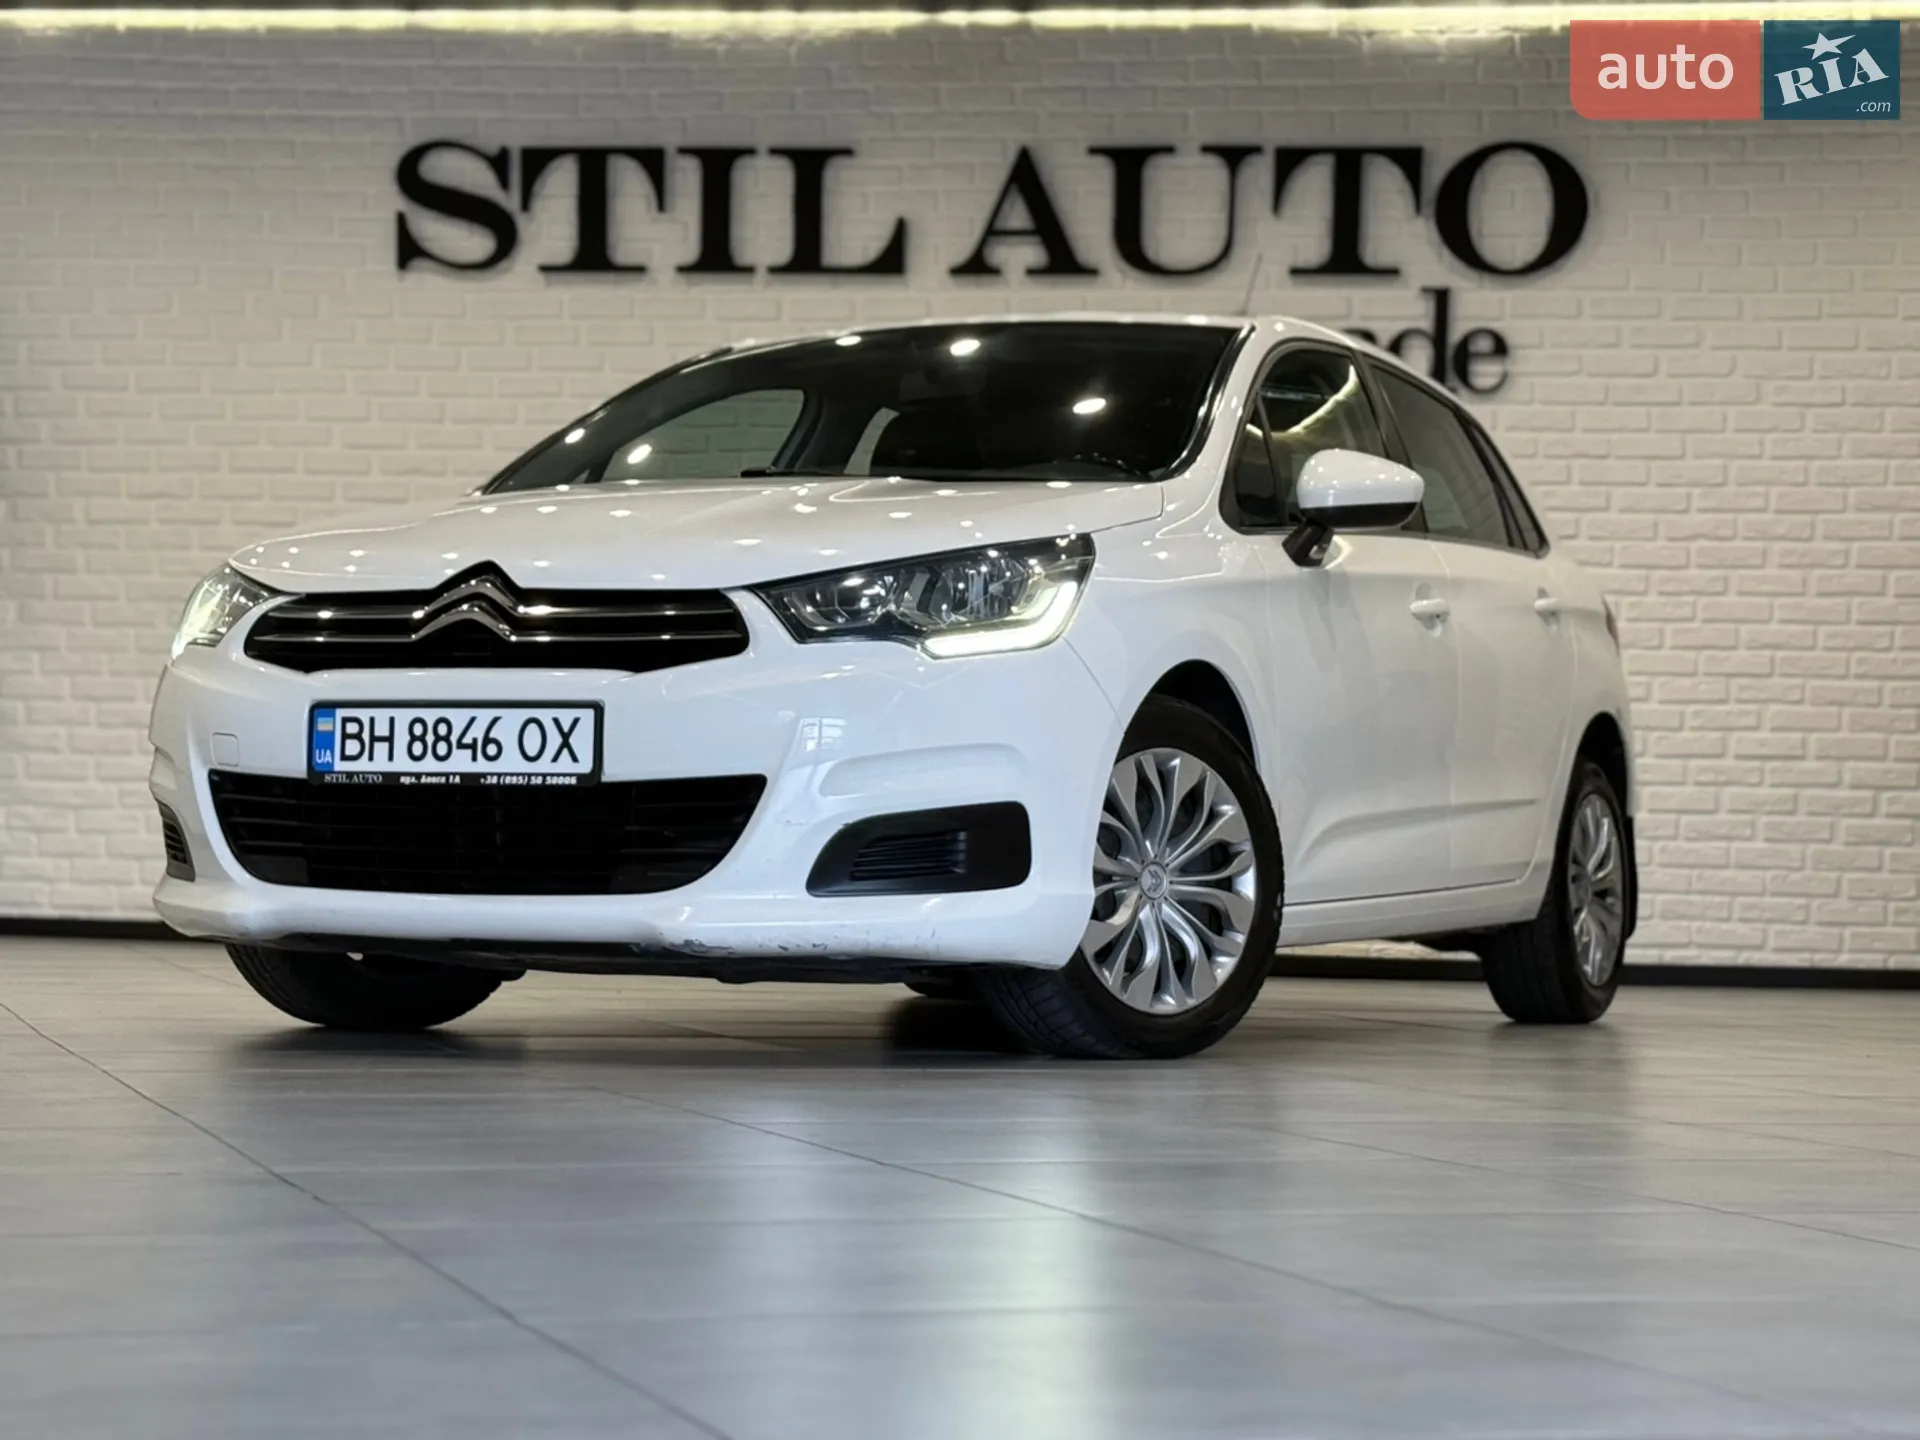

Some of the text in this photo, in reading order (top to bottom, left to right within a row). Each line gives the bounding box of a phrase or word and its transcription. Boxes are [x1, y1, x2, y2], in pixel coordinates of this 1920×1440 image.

[396, 140, 1589, 275] STIL AUTO
[1343, 286, 1509, 394] de
[315, 751, 333, 764] UA
[339, 716, 582, 764] BH 8846 OX
[324, 774, 383, 784] STIL AUTO
